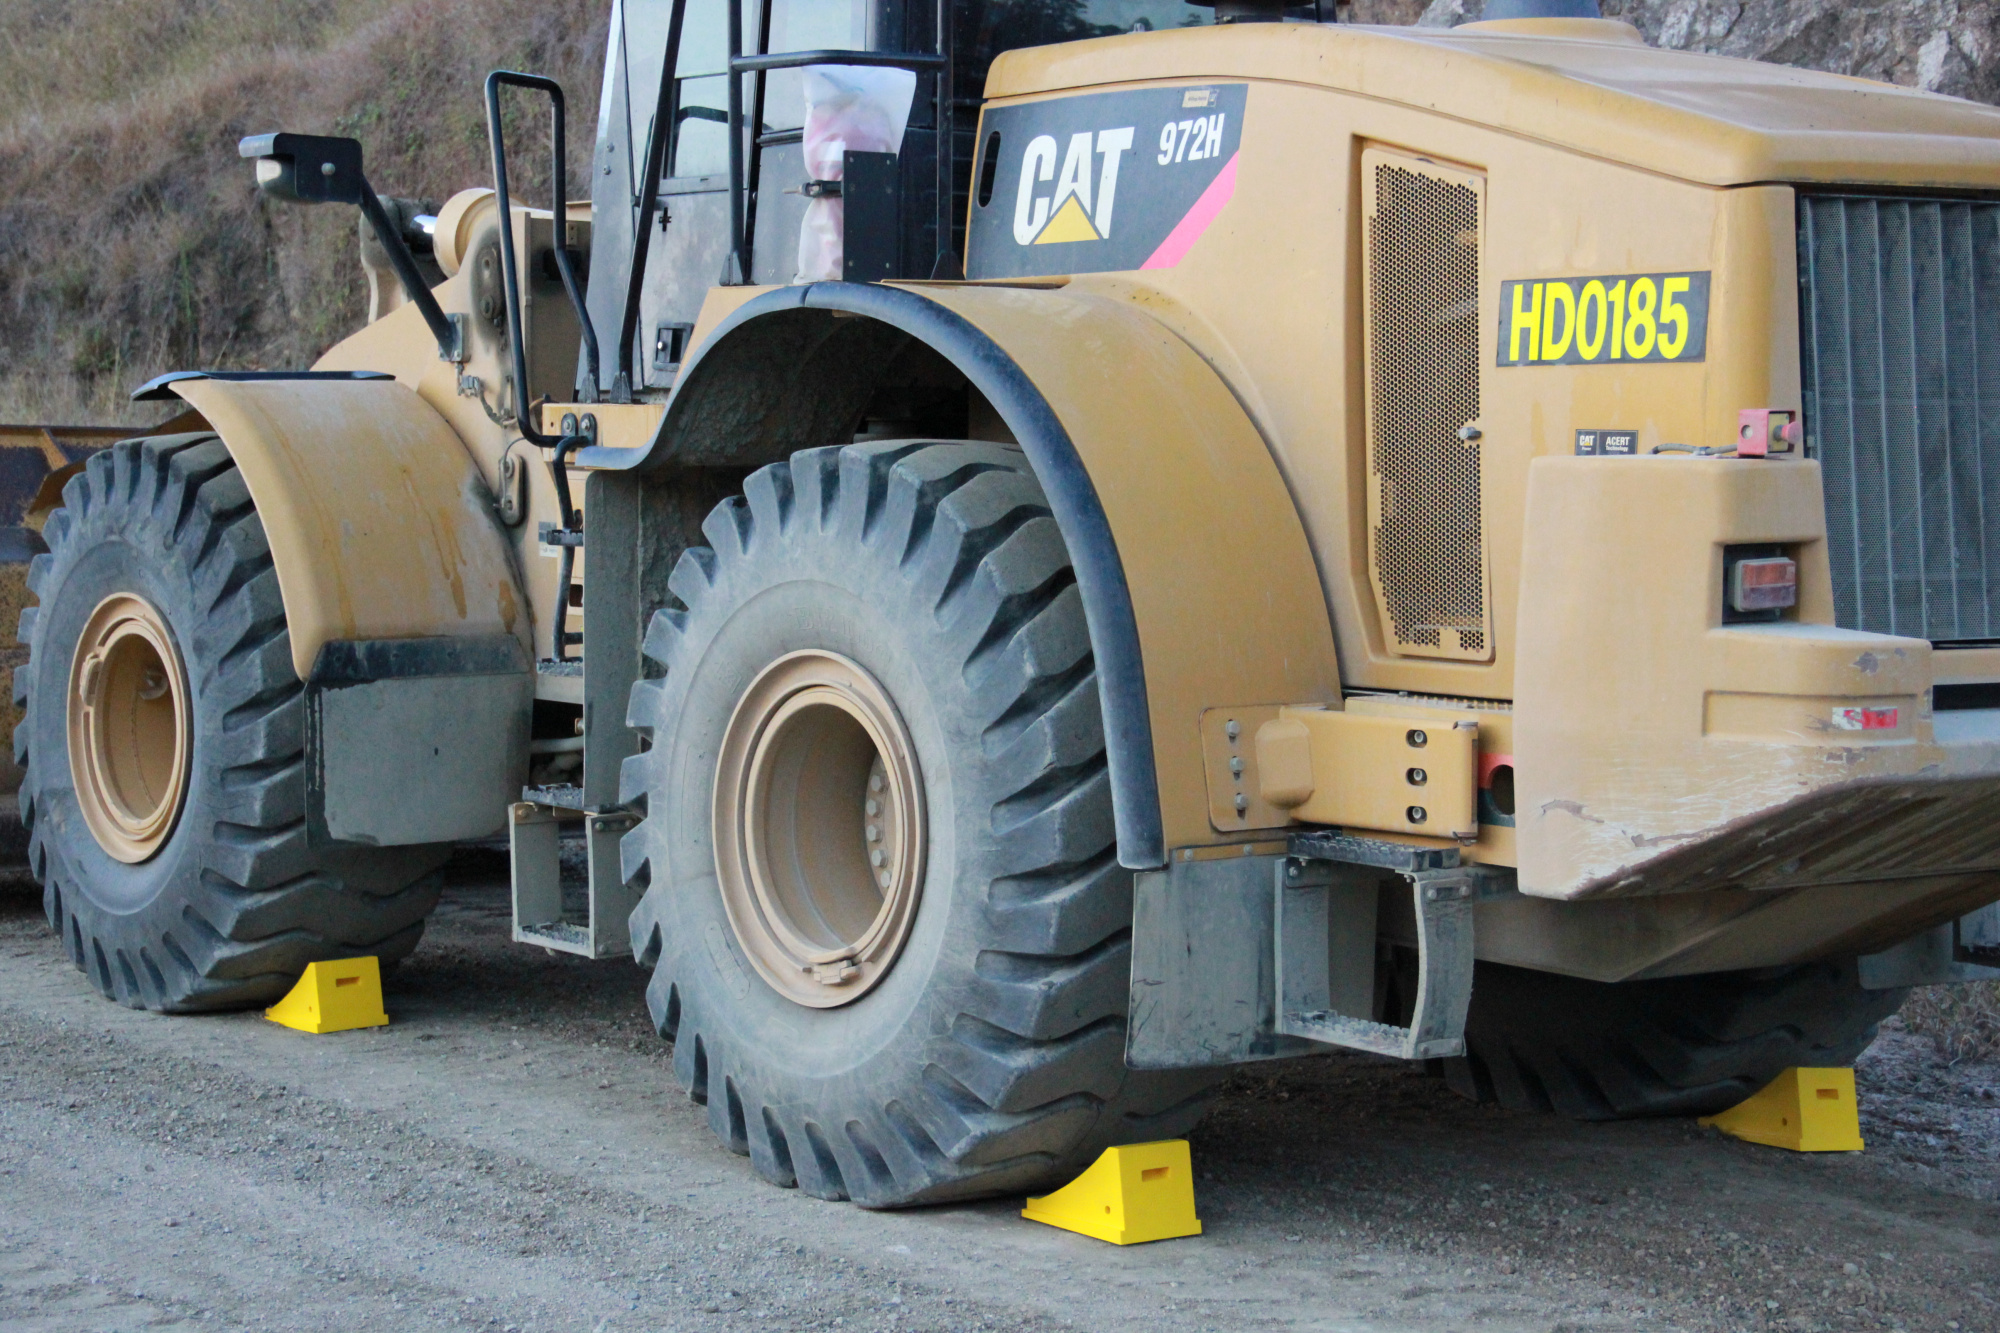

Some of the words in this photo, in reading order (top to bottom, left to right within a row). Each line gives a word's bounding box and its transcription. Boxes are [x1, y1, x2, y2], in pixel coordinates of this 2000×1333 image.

[1157, 113, 1226, 166] 972H
[1013, 127, 1135, 246] CAT
[1509, 276, 1690, 361] HD0185
[1579, 435, 1595, 446] CAT
[1605, 436, 1630, 446] ACERT
